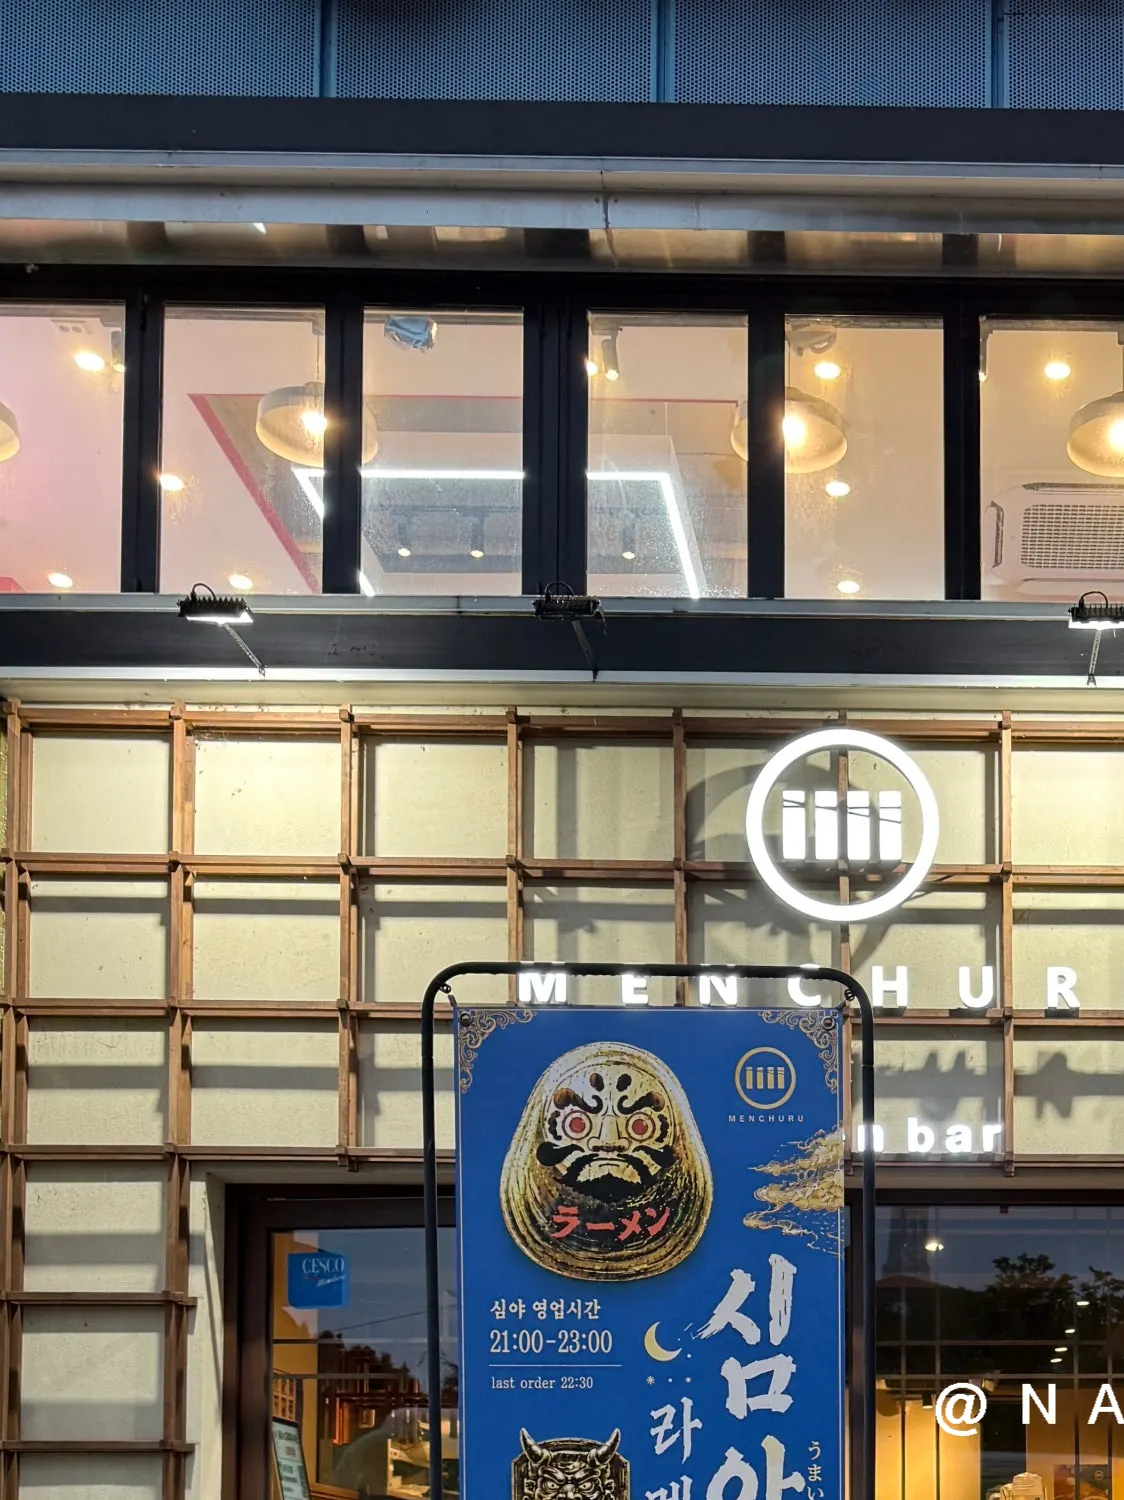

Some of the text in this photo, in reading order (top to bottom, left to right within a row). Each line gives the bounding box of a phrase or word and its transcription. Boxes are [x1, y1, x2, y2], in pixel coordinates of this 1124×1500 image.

[907, 1116, 1003, 1153] bar
[551, 1205, 671, 1242] ラーメン
[302, 1257, 345, 1274] CESCO
[490, 1299, 601, 1319] 심야 영업시간
[490, 1330, 613, 1353] 21:00-23:00
[492, 1377, 593, 1389] last order 22:30
